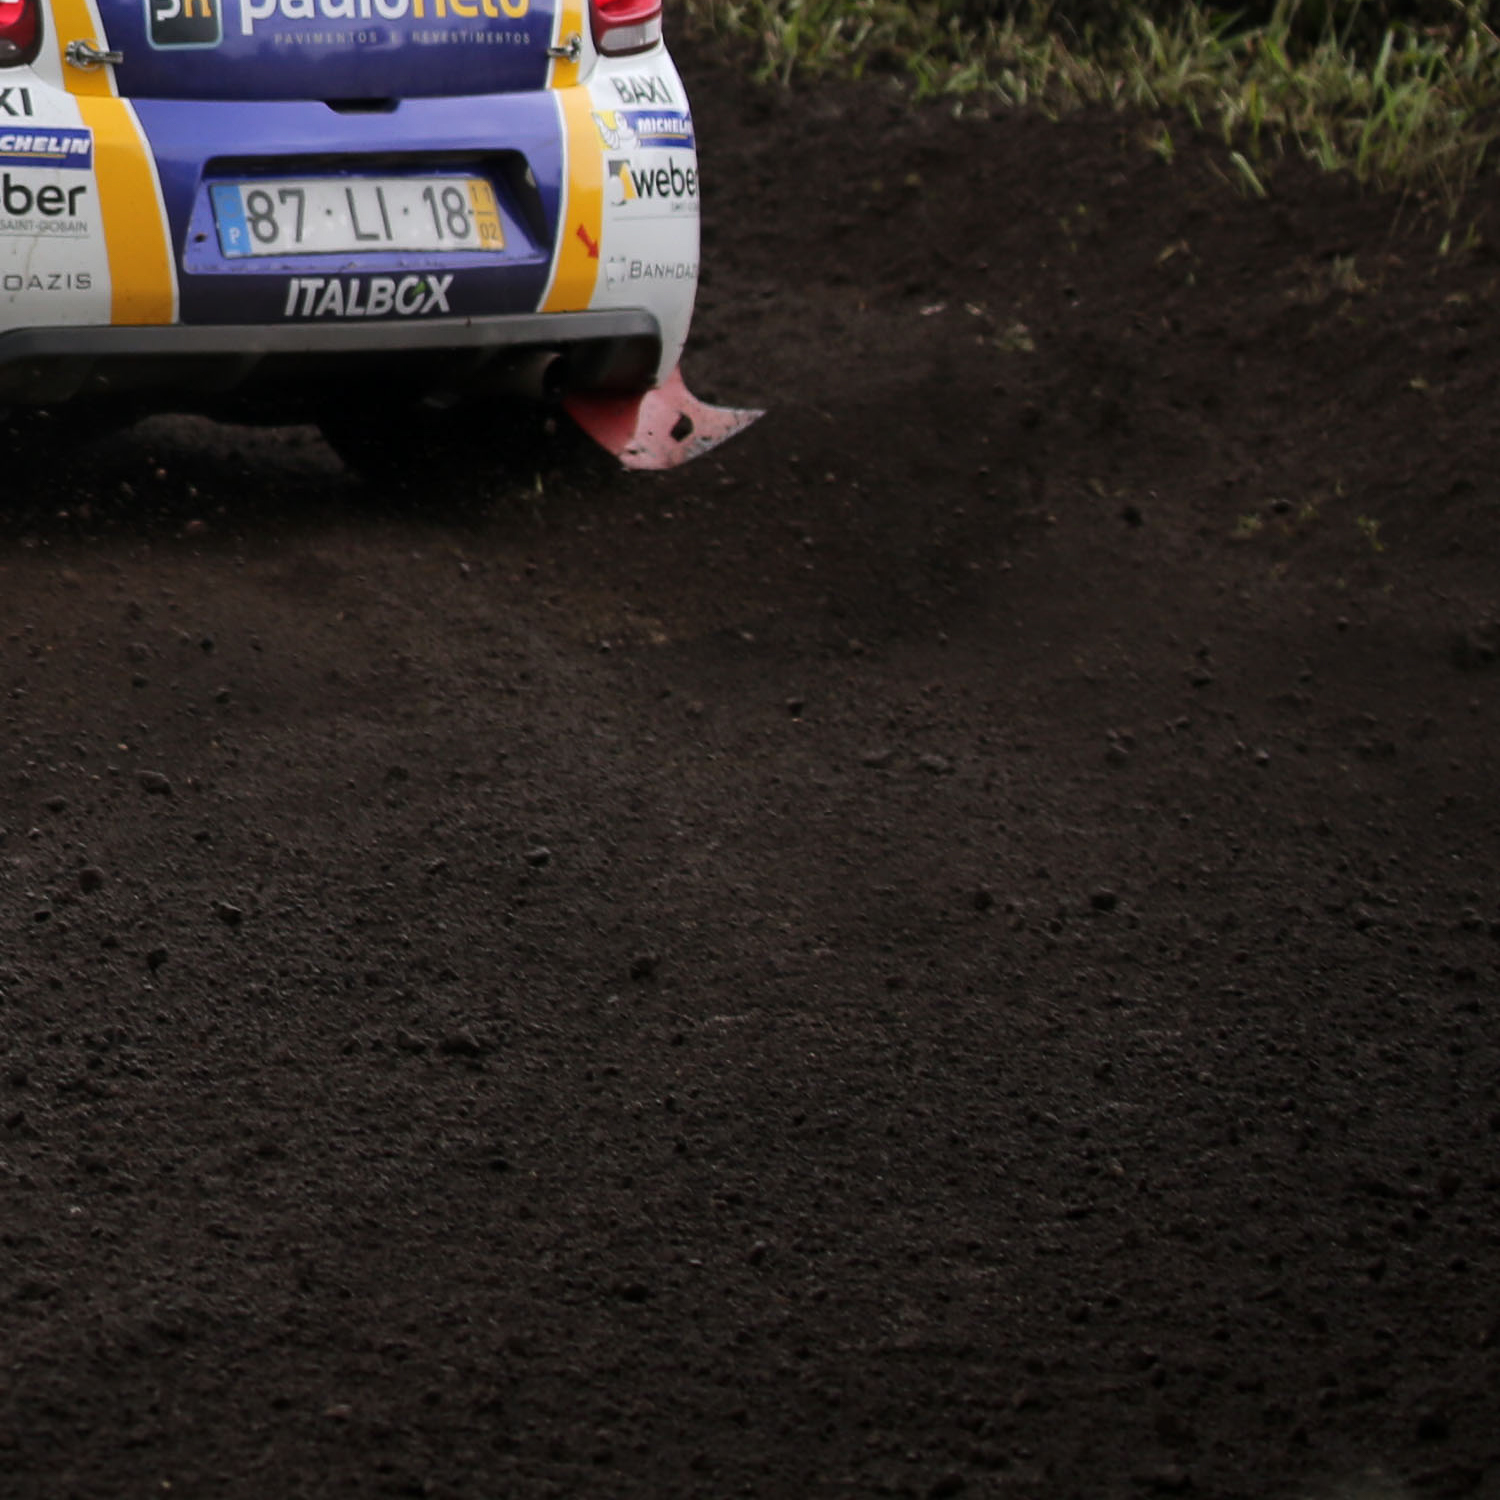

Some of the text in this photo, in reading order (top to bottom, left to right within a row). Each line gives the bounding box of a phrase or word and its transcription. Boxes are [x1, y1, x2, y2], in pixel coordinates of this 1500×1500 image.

[274, 31, 378, 46] PAVIMENTOS
[412, 30, 532, 46] REVESTIMENTOS
[610, 76, 674, 104] BAXI
[284, 274, 455, 317] ITALBOX
